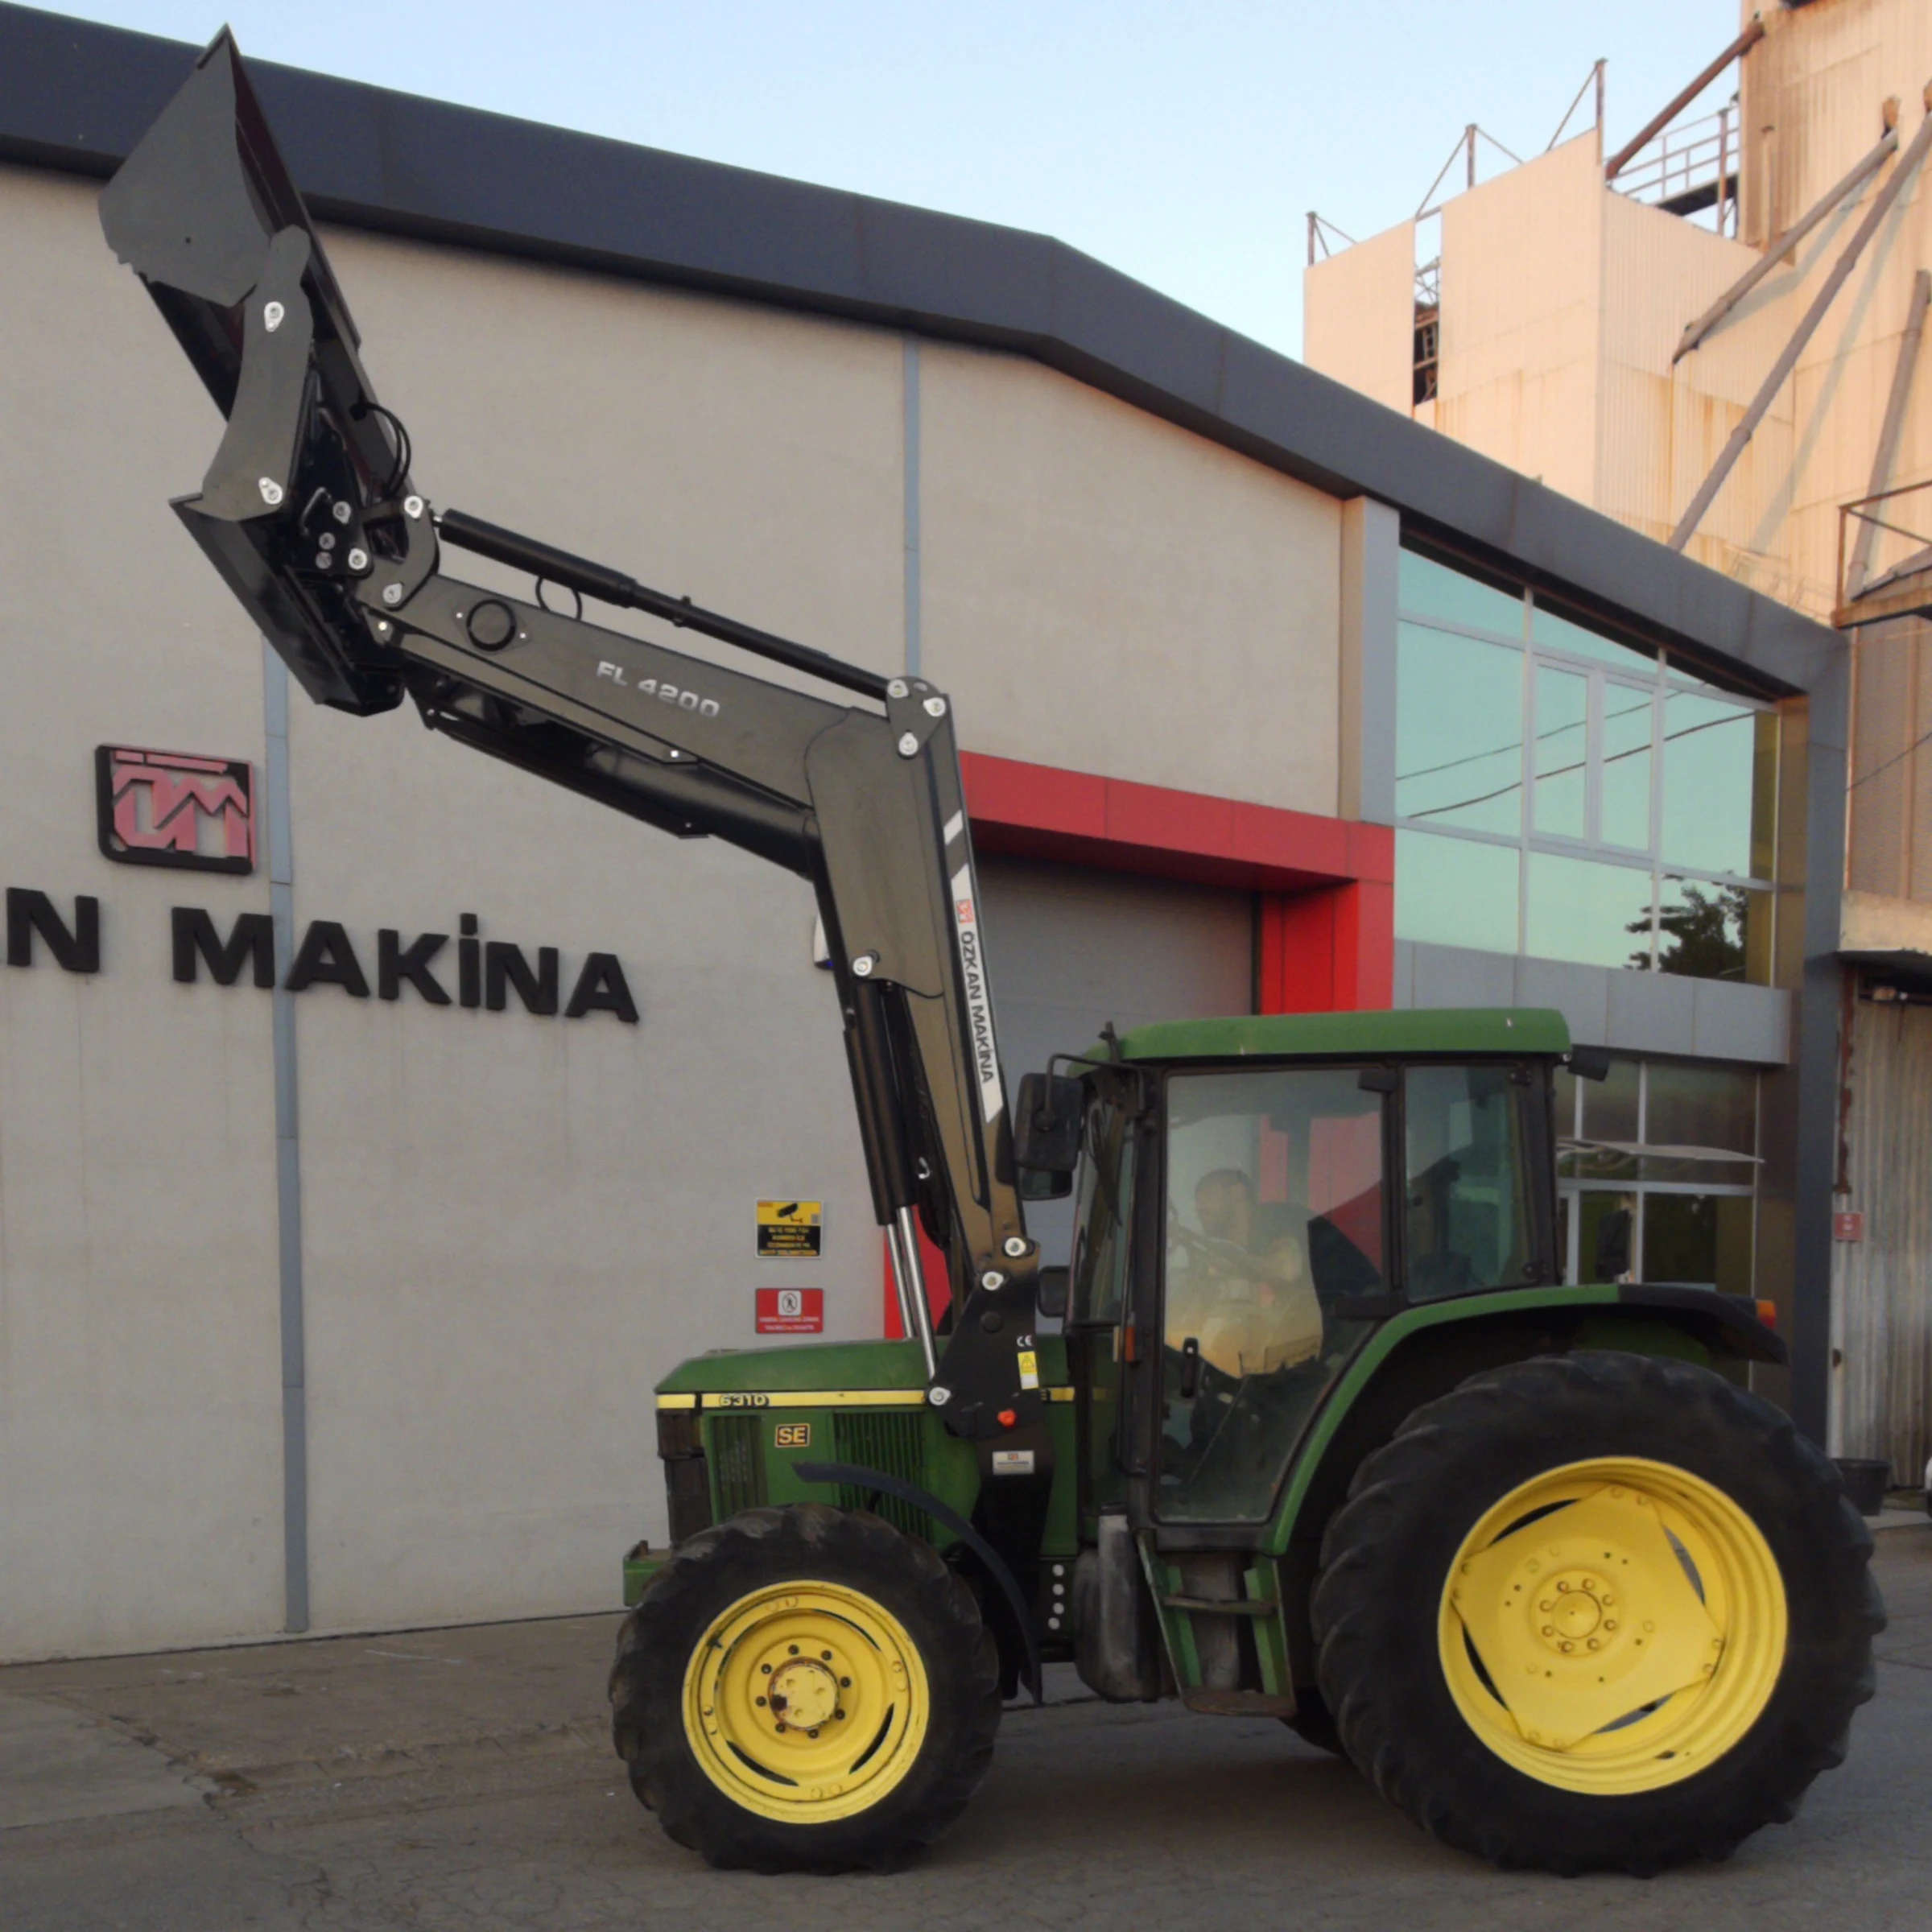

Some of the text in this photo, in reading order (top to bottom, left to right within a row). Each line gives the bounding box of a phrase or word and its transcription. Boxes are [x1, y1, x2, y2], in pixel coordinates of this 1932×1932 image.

[597, 660, 720, 717] FL 4200
[720, 1393, 768, 1407] 6310
[778, 1427, 807, 1443] SE
